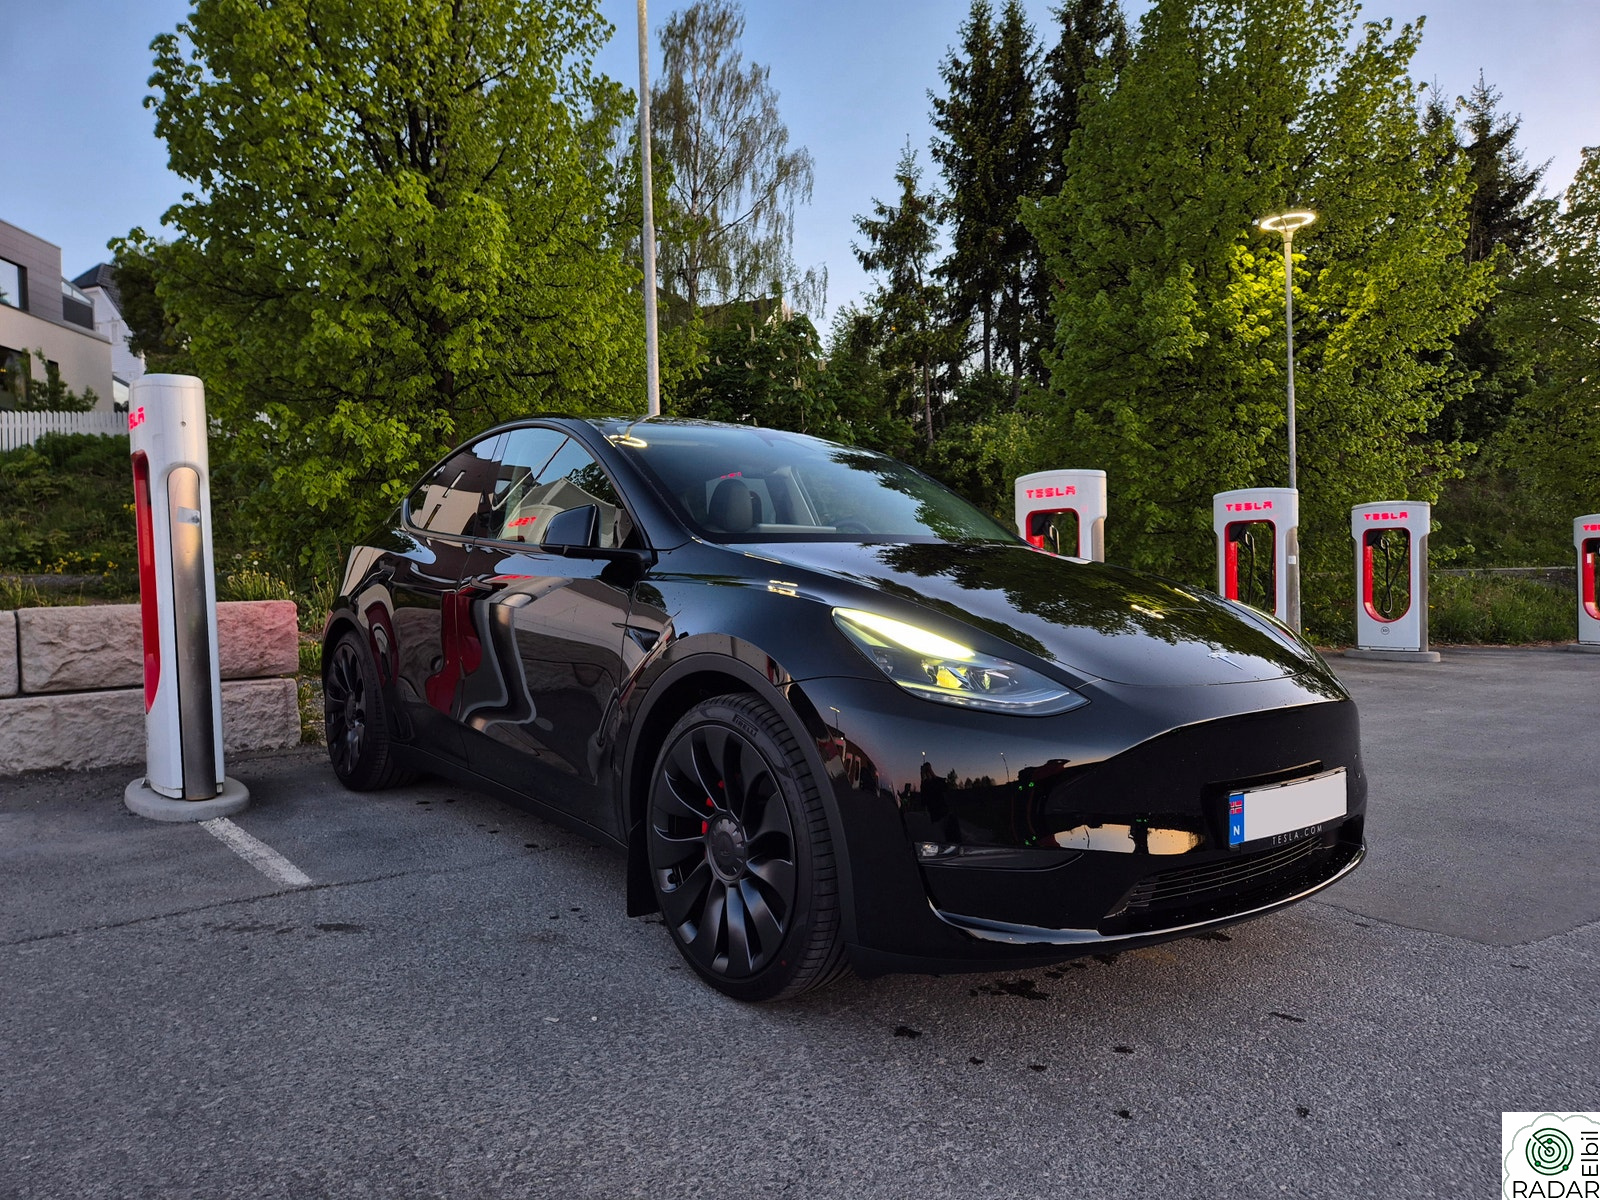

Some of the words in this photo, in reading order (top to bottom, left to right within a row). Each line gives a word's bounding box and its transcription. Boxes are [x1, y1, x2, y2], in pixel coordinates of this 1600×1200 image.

[1026, 486, 1076, 499] TESLA
[1225, 501, 1273, 512] TESLA
[1364, 511, 1408, 520] TESLA
[1233, 825, 1240, 836] N
[1272, 825, 1322, 845] TESLA.COM
